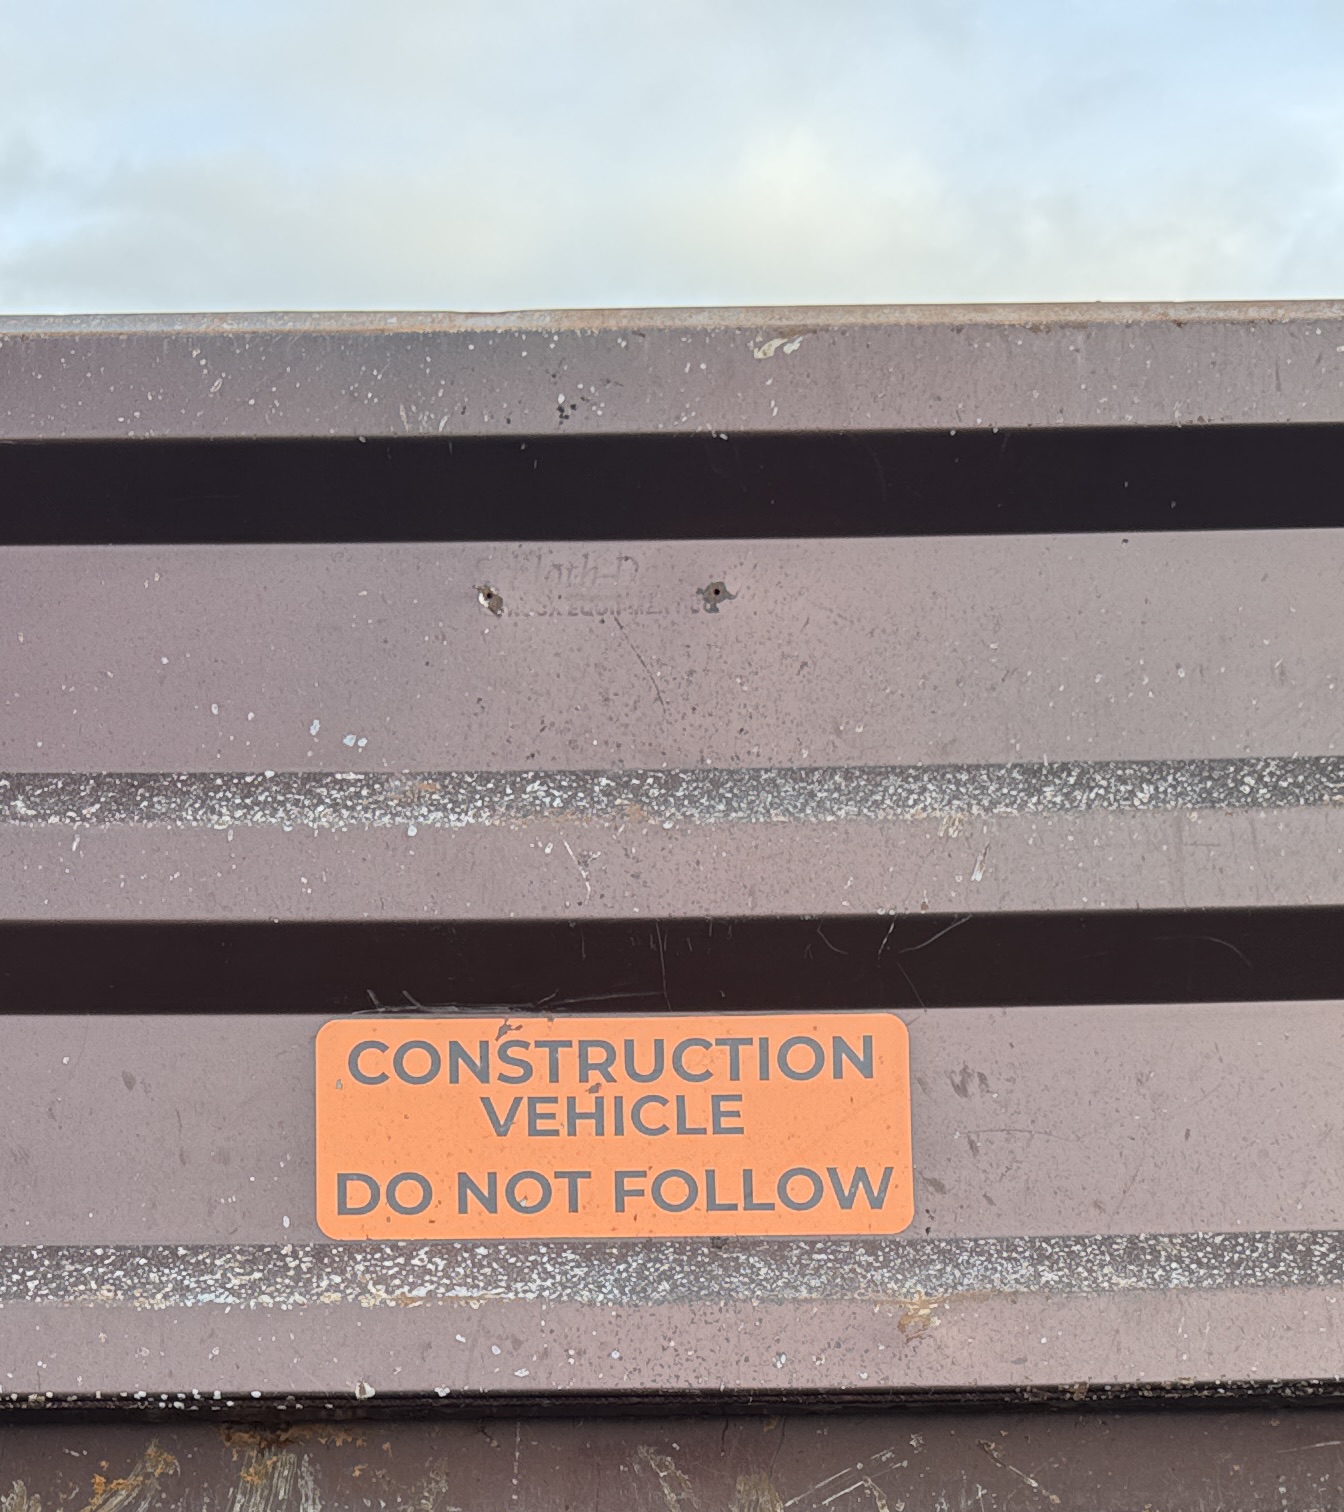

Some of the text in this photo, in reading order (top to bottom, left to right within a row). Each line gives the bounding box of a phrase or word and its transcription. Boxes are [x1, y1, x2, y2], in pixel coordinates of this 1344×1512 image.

[347, 1034, 874, 1086] CONSTRUCTION
[480, 1093, 745, 1138] VEHICLE
[335, 1166, 895, 1216] DO NOT FOLLOW
